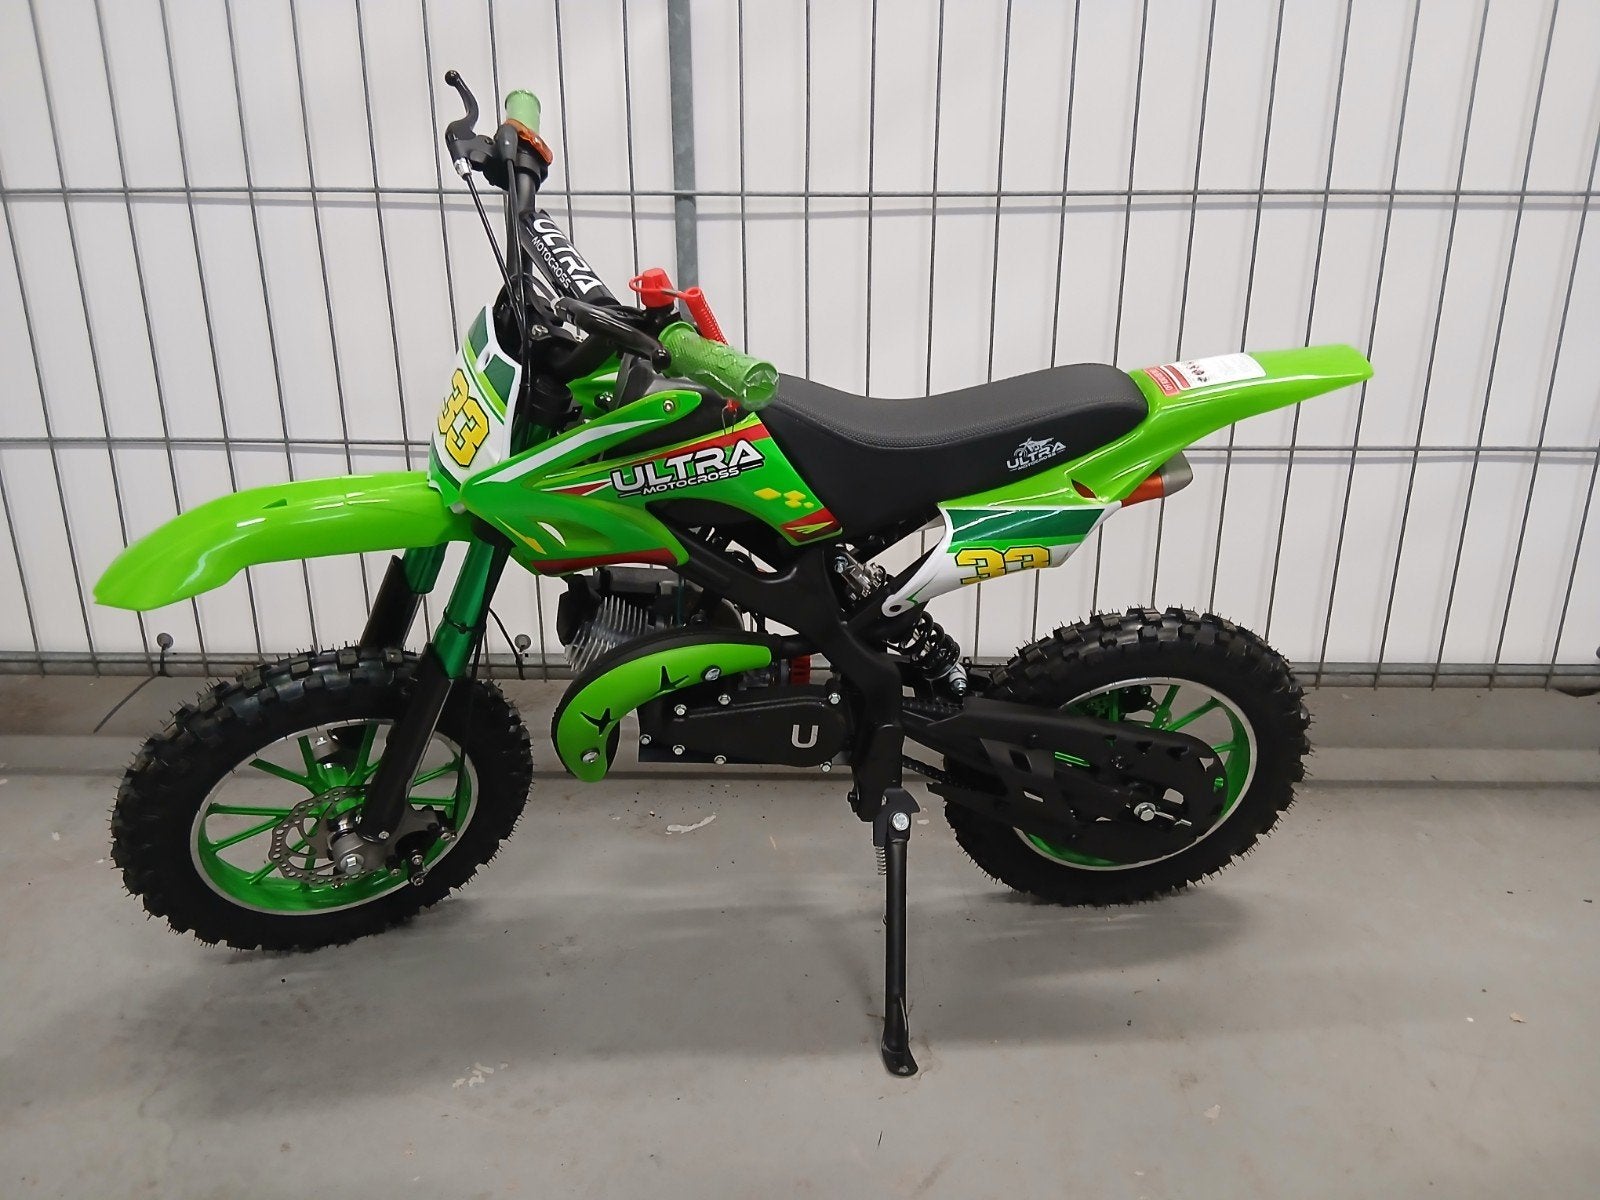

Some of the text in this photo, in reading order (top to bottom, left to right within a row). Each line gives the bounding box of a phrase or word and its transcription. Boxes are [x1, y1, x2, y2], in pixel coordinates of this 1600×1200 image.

[532, 236, 571, 289] MOTOCROSS
[533, 218, 603, 295] ULTRA
[438, 368, 490, 467] 33
[612, 439, 764, 491] ULTRA
[1006, 441, 1067, 469] ULTRA
[643, 467, 740, 495] MOTOCROSS
[955, 545, 1051, 585] 33
[791, 724, 819, 748] U
